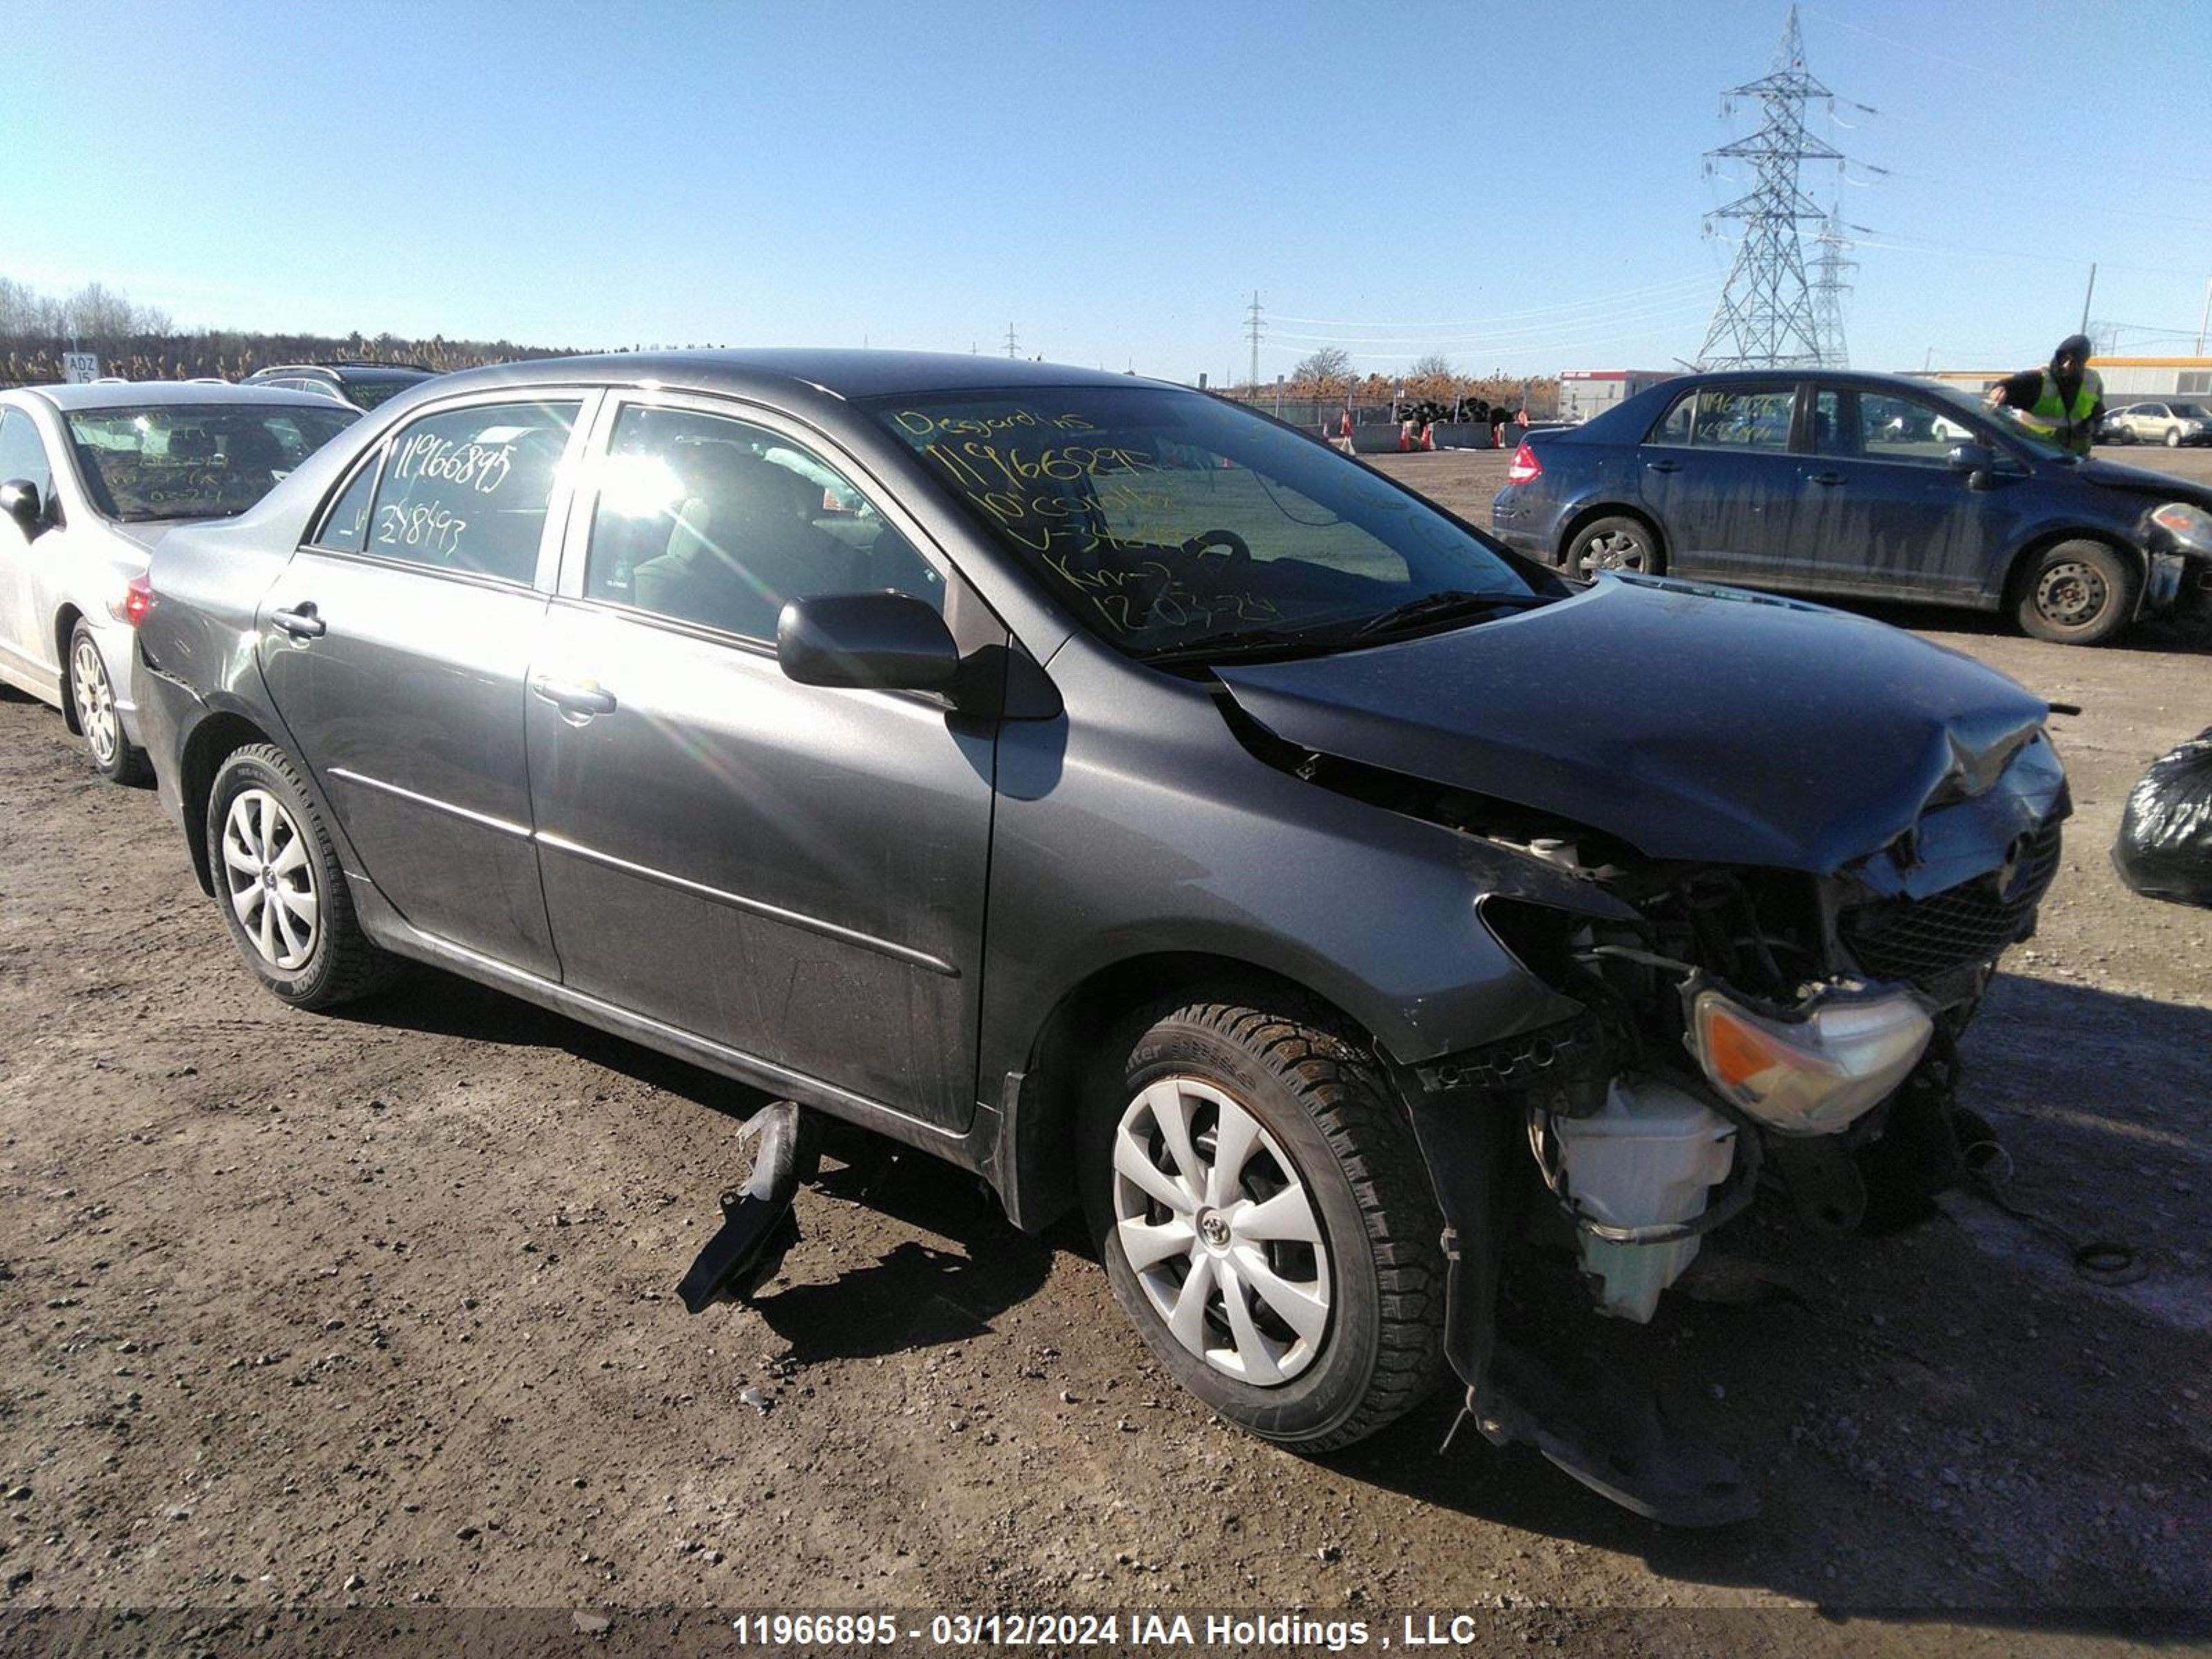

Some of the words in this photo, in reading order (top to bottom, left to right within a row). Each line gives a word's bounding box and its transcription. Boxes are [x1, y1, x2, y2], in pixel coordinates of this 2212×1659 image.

[894, 408, 1094, 438] Desjardins
[394, 433, 517, 493] 11966895
[926, 441, 1163, 491] 11966895
